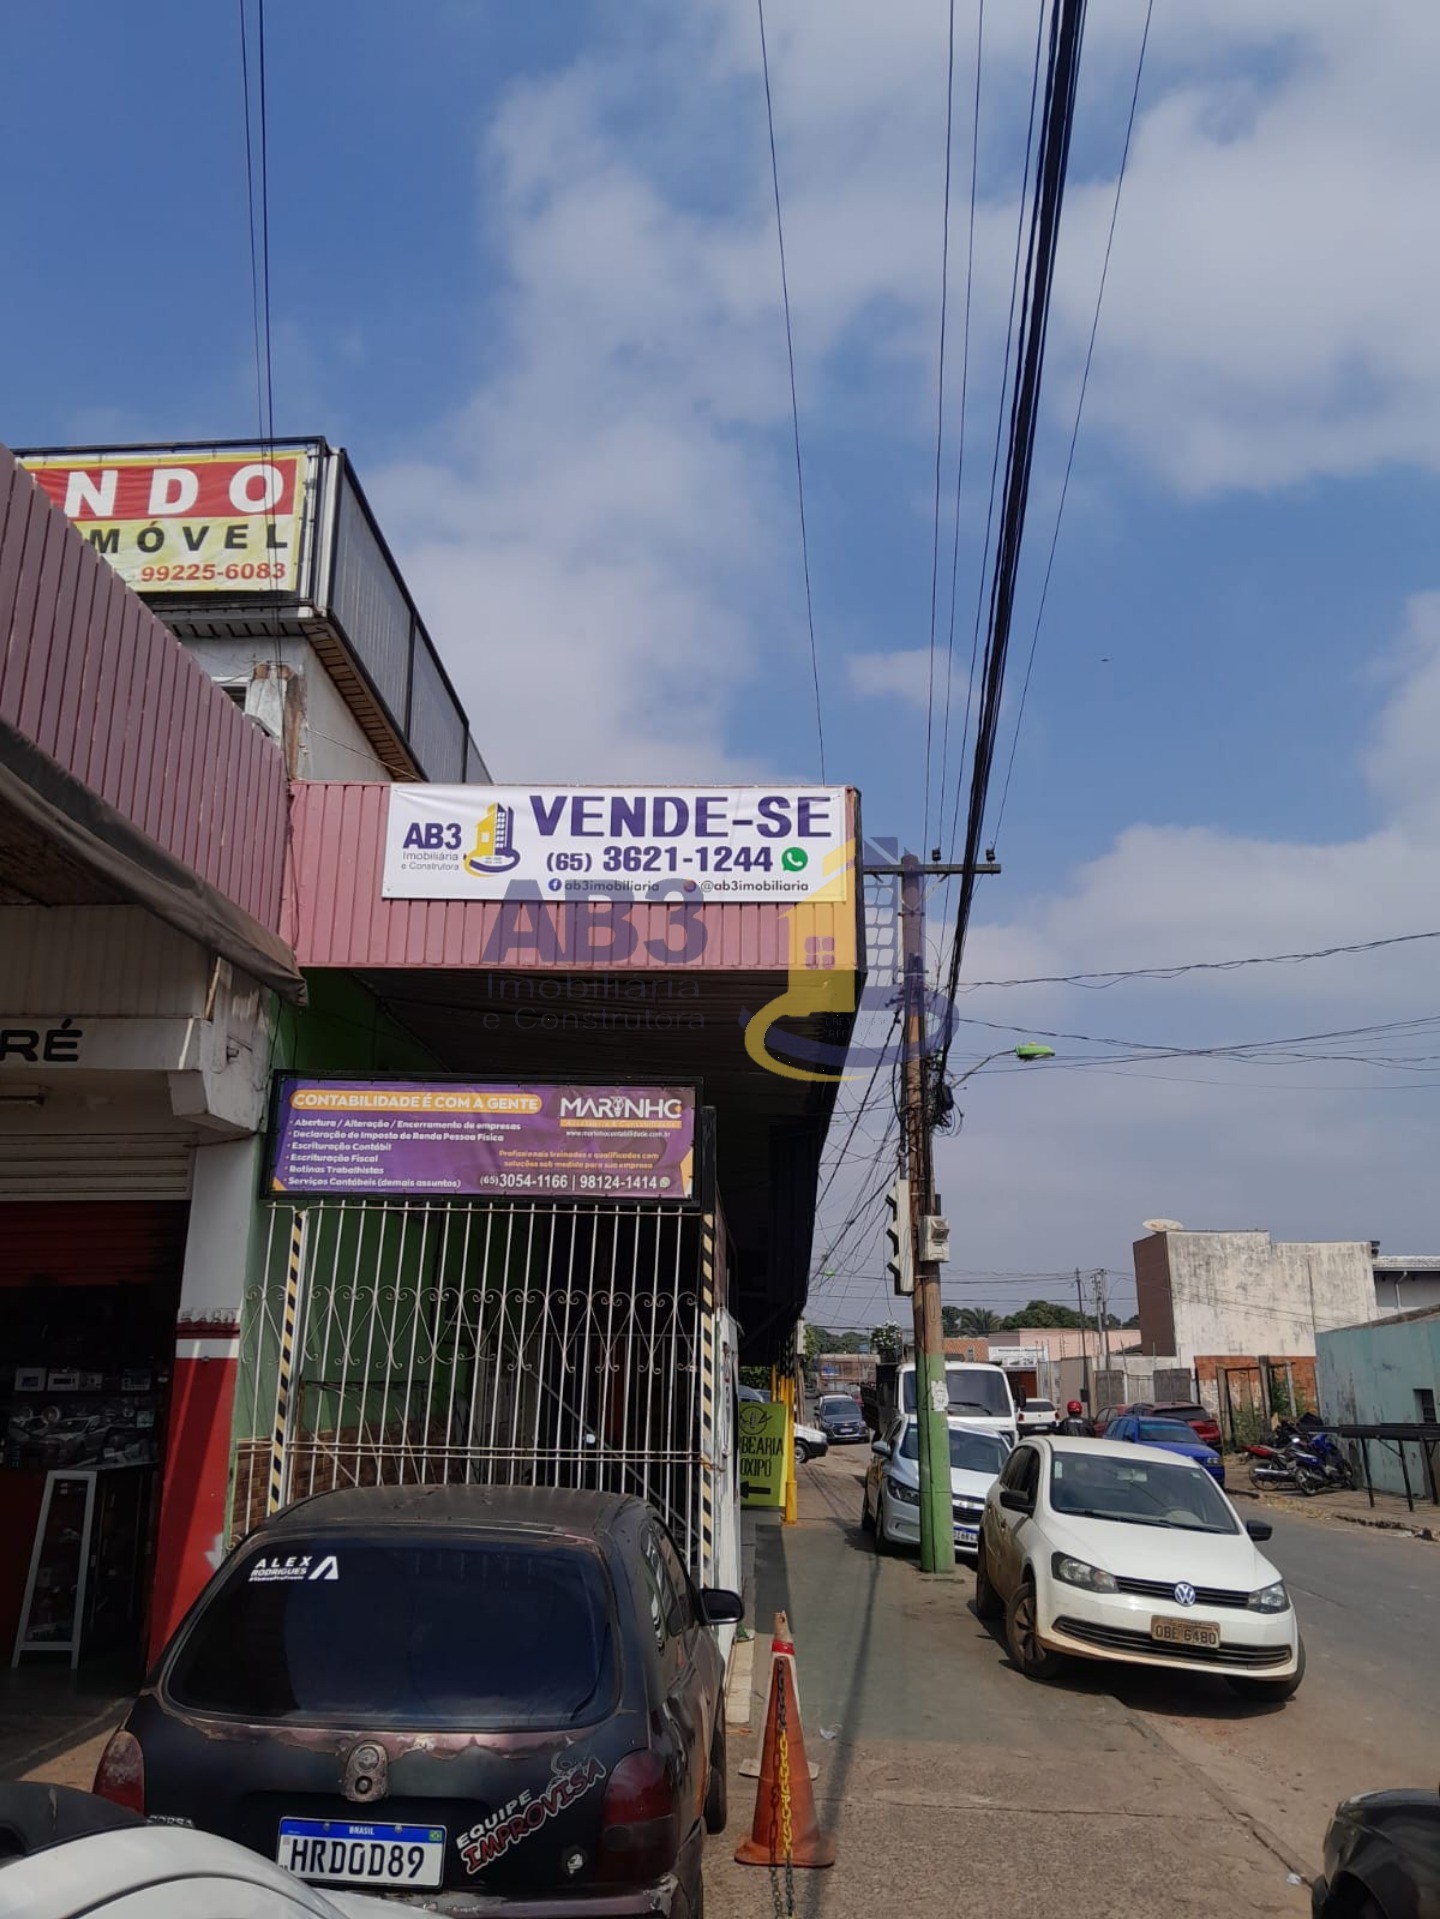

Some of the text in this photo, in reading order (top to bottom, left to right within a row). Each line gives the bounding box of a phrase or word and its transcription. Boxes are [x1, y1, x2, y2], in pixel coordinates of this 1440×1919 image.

[141, 562, 286, 582] 99225-6083
[529, 795, 832, 838] VENDE-SE
[402, 822, 462, 850] AB3
[402, 850, 459, 861] Imobiliária
[546, 845, 774, 873] (65) 3621-1244
[408, 862, 459, 871] Construtora
[564, 880, 660, 892] ab3imobiliaria
[701, 880, 809, 893] @ab3imobiliaria
[0, 1018, 83, 1062] RÉ
[293, 1092, 538, 1110] CONTABILIDADE É COM A GENTE
[343, 1119, 390, 1129] Alteração
[397, 1120, 462, 1129] Encerramento
[463, 1121, 475, 1129] de
[476, 1122, 521, 1131] empresas
[293, 1131, 347, 1140] Declaração
[347, 1131, 359, 1139] de
[361, 1132, 398, 1140] Imposto
[400, 1132, 411, 1140] de
[413, 1132, 442, 1140] Renda
[443, 1133, 476, 1141] Pessoa
[292, 1142, 392, 1152] Escrituração Contábil
[290, 1153, 379, 1163] Escrituração Fiscal
[289, 1164, 384, 1175] Rotinas Trabalhistas
[288, 1176, 328, 1186] Serviços
[378, 1178, 415, 1187] (demais
[416, 1179, 461, 1188] assuntos)
[580, 1175, 657, 1189] 98124-1414
[254, 1556, 313, 1568] ALEX
[250, 1567, 307, 1577] RODRIGUES
[456, 1789, 533, 1849] EQUIPE
[461, 1756, 606, 1875] IMPROVISA
[349, 1826, 375, 1836] BRASIL
